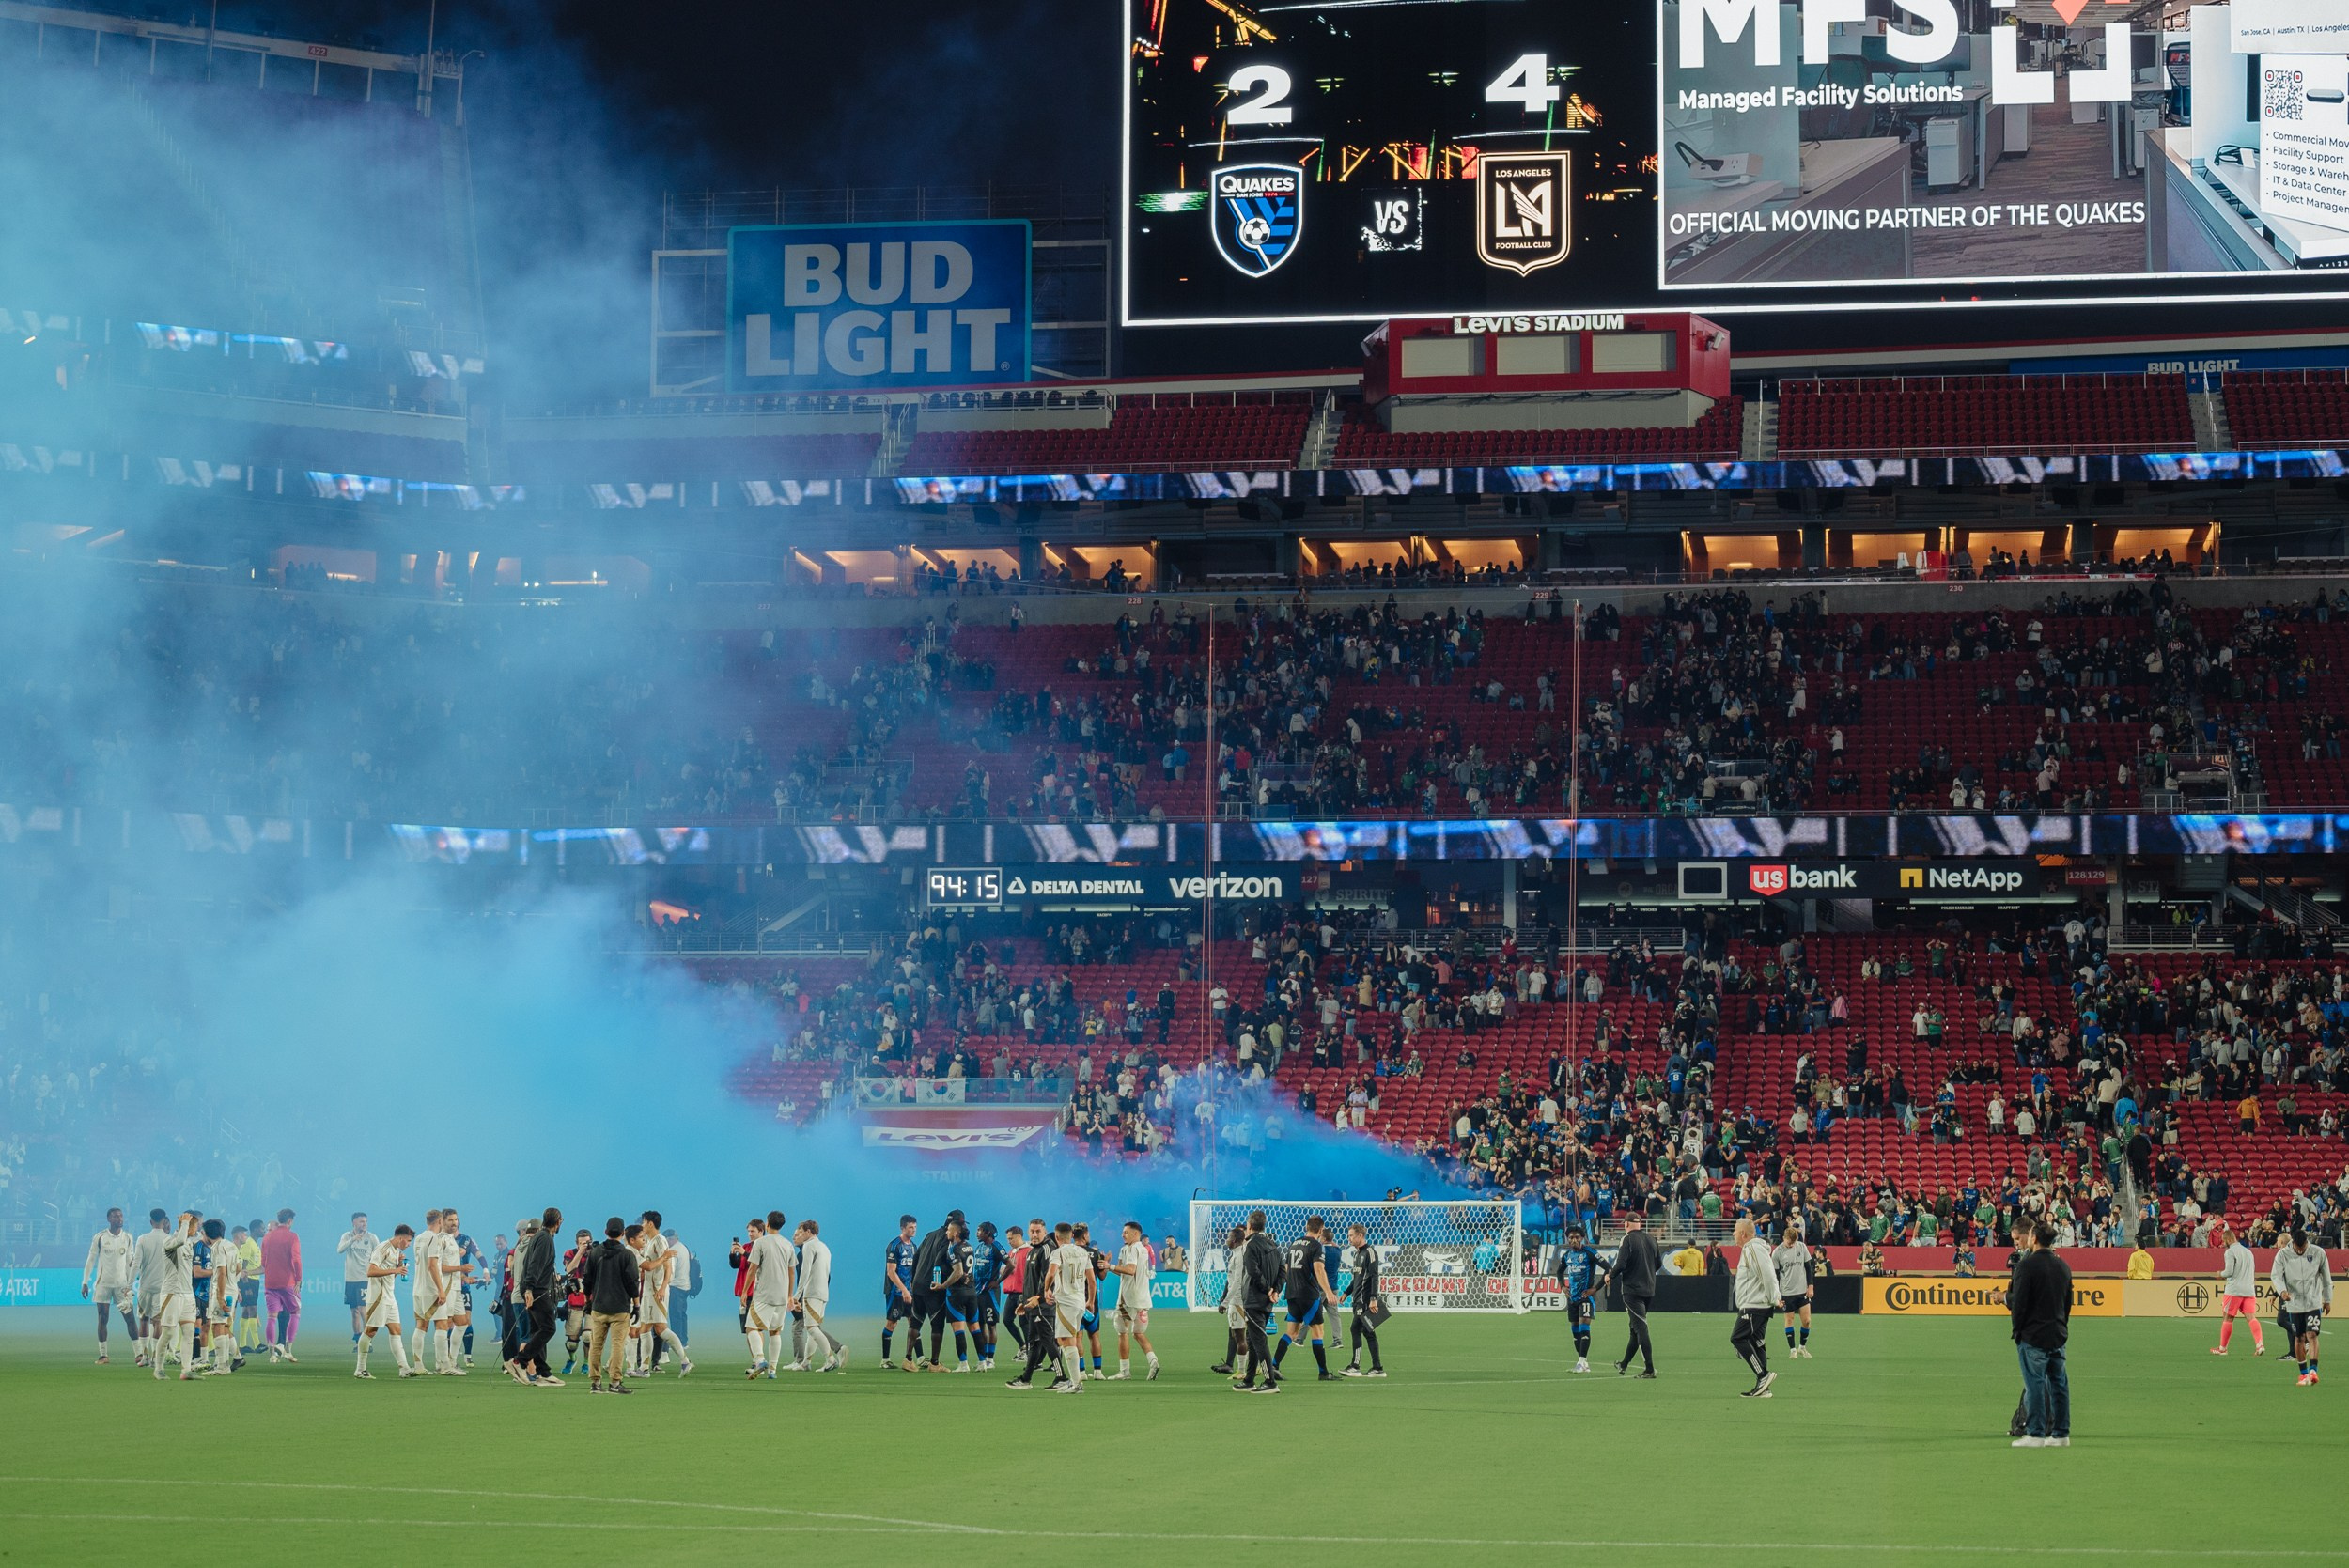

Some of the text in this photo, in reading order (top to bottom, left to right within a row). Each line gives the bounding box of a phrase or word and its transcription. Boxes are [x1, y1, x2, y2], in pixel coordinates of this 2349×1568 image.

[2277, 26, 2296, 35] Austin,
[1485, 54, 1560, 112] 4
[1227, 65, 1293, 124] 2
[1679, 81, 1964, 113] Managed Facility Solutions
[2273, 131, 2326, 146] Commercial
[2273, 146, 2344, 164] Facility Support
[1496, 168, 1551, 178] LOS ANGELES
[2272, 161, 2307, 176] Storage
[2309, 166, 2315, 176] &
[1220, 176, 1295, 194] QUAKES
[2273, 175, 2347, 197] IT & Data Center
[2273, 190, 2304, 204] Project
[1375, 200, 1409, 234] VS
[1669, 201, 2146, 235] OFFICIAL MOVING PARTNER OF THE QUAKES
[1495, 241, 1552, 250] FOOTBALL CLUB
[784, 241, 974, 306] BUD
[1534, 314, 1625, 332] STADIUM
[746, 308, 1011, 376] LIGHT
[2147, 359, 2240, 374] BUD LIGHT
[1301, 876, 1318, 884] 127
[1753, 864, 1857, 889] us bank
[1929, 868, 2023, 892] NetApp
[2068, 871, 2105, 879] 128 129
[931, 874, 999, 898] 94:15
[1031, 879, 1144, 894] DELTA DENTAL
[1169, 871, 1283, 899] verizon
[966, 1255, 975, 1275] 9
[1290, 1250, 1304, 1269] 12
[5, 1278, 40, 1296] AT&T
[1378, 1277, 1468, 1294] ISCOUNT
[1393, 1296, 1438, 1306] TIRE
[1582, 1302, 1591, 1312] 11
[986, 1307, 994, 1317] 2
[2307, 1315, 2321, 1327] 26
